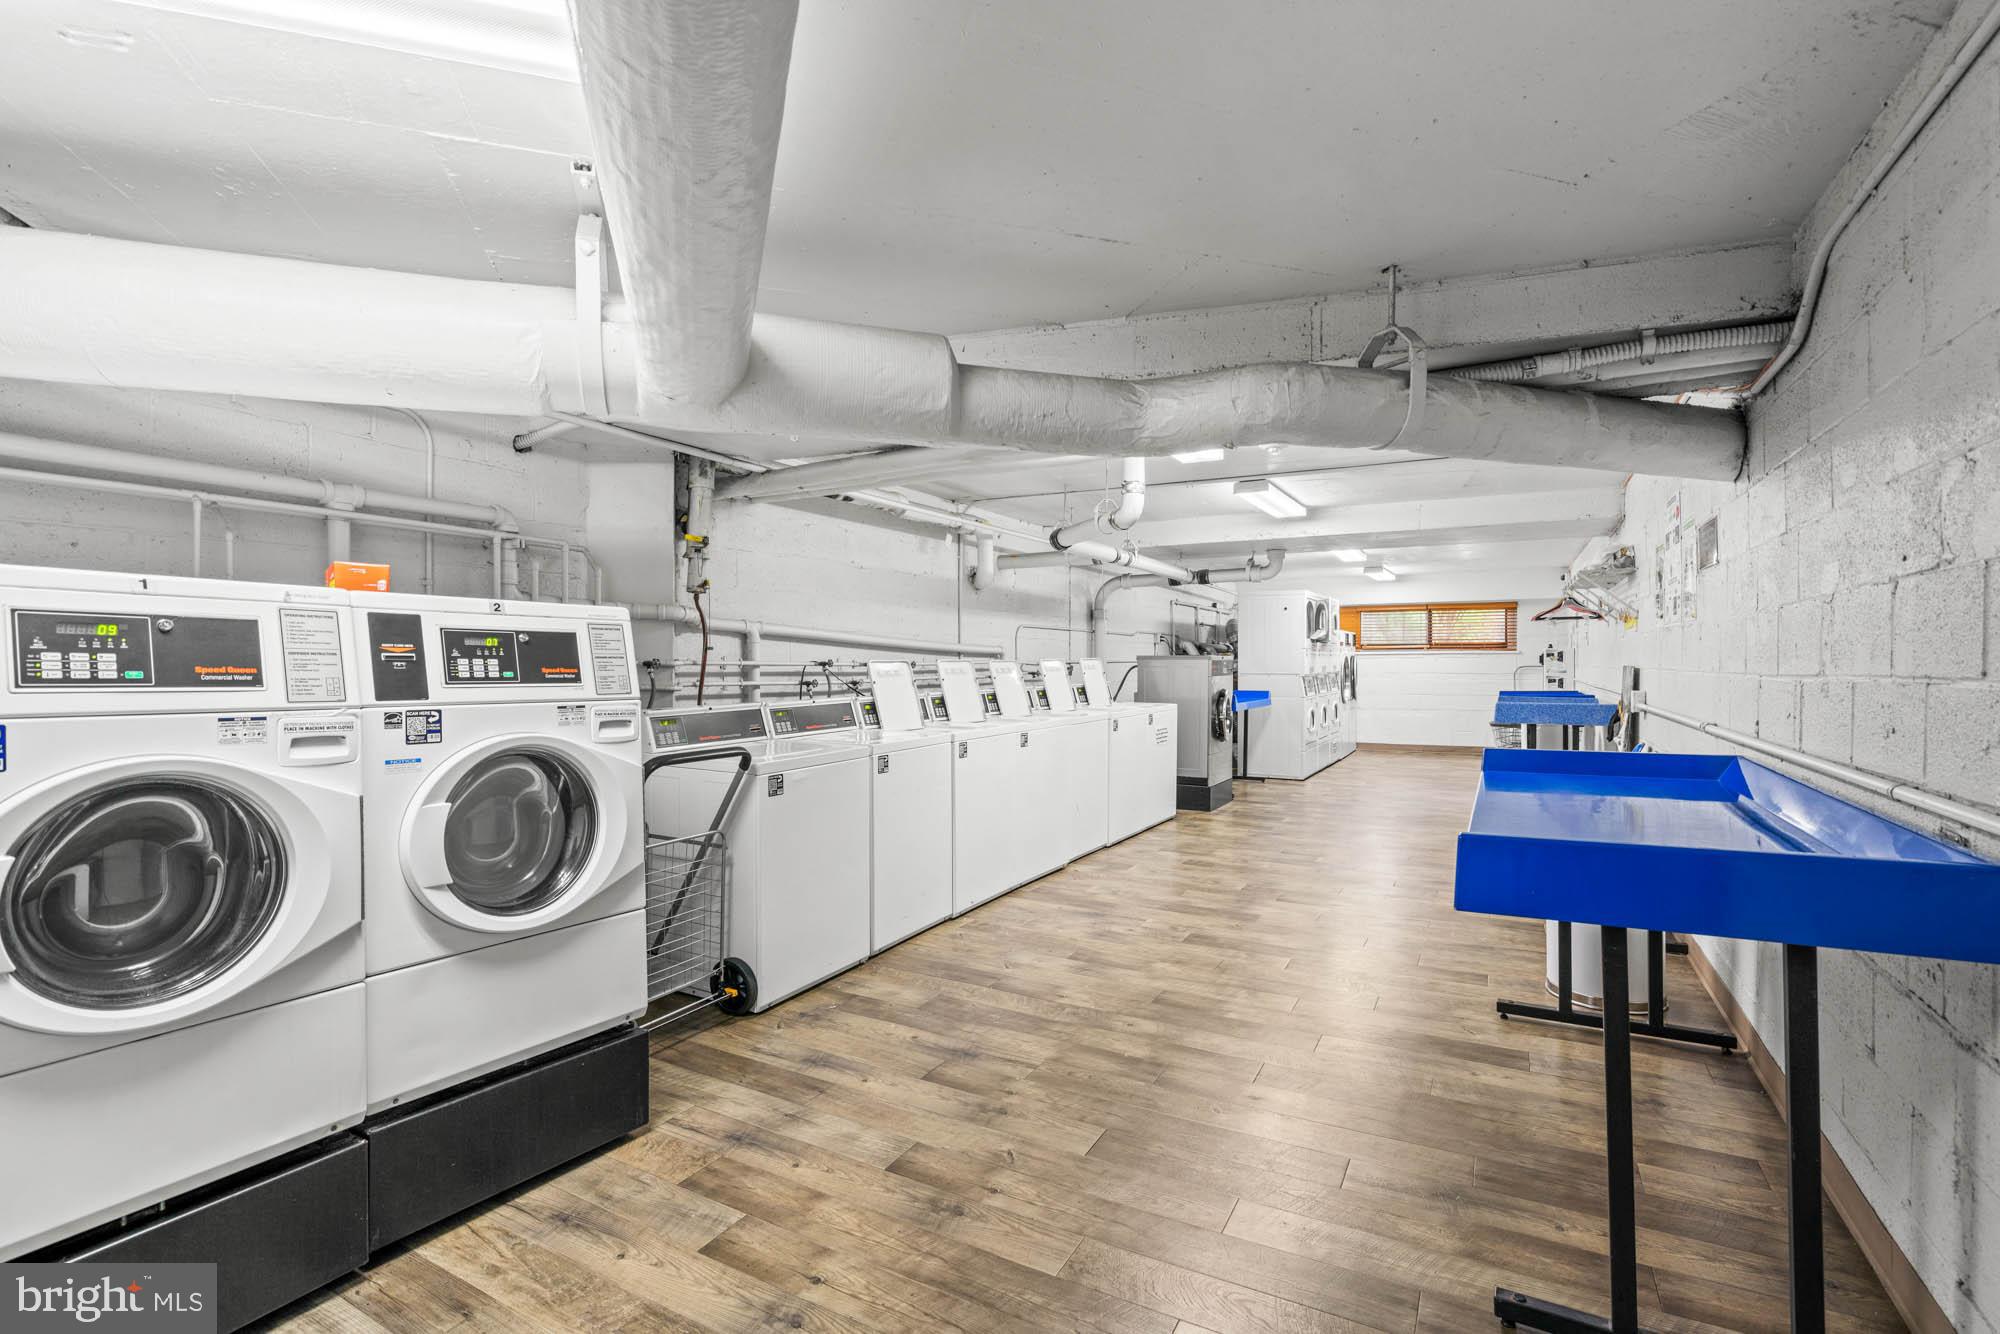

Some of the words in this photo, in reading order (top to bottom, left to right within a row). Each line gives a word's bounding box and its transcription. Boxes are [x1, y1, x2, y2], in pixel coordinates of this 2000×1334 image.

[138, 578, 148, 590] 1
[493, 602, 502, 612] 2
[97, 624, 118, 636] 09
[194, 666, 226, 675] Speed
[227, 666, 257, 674] Queen
